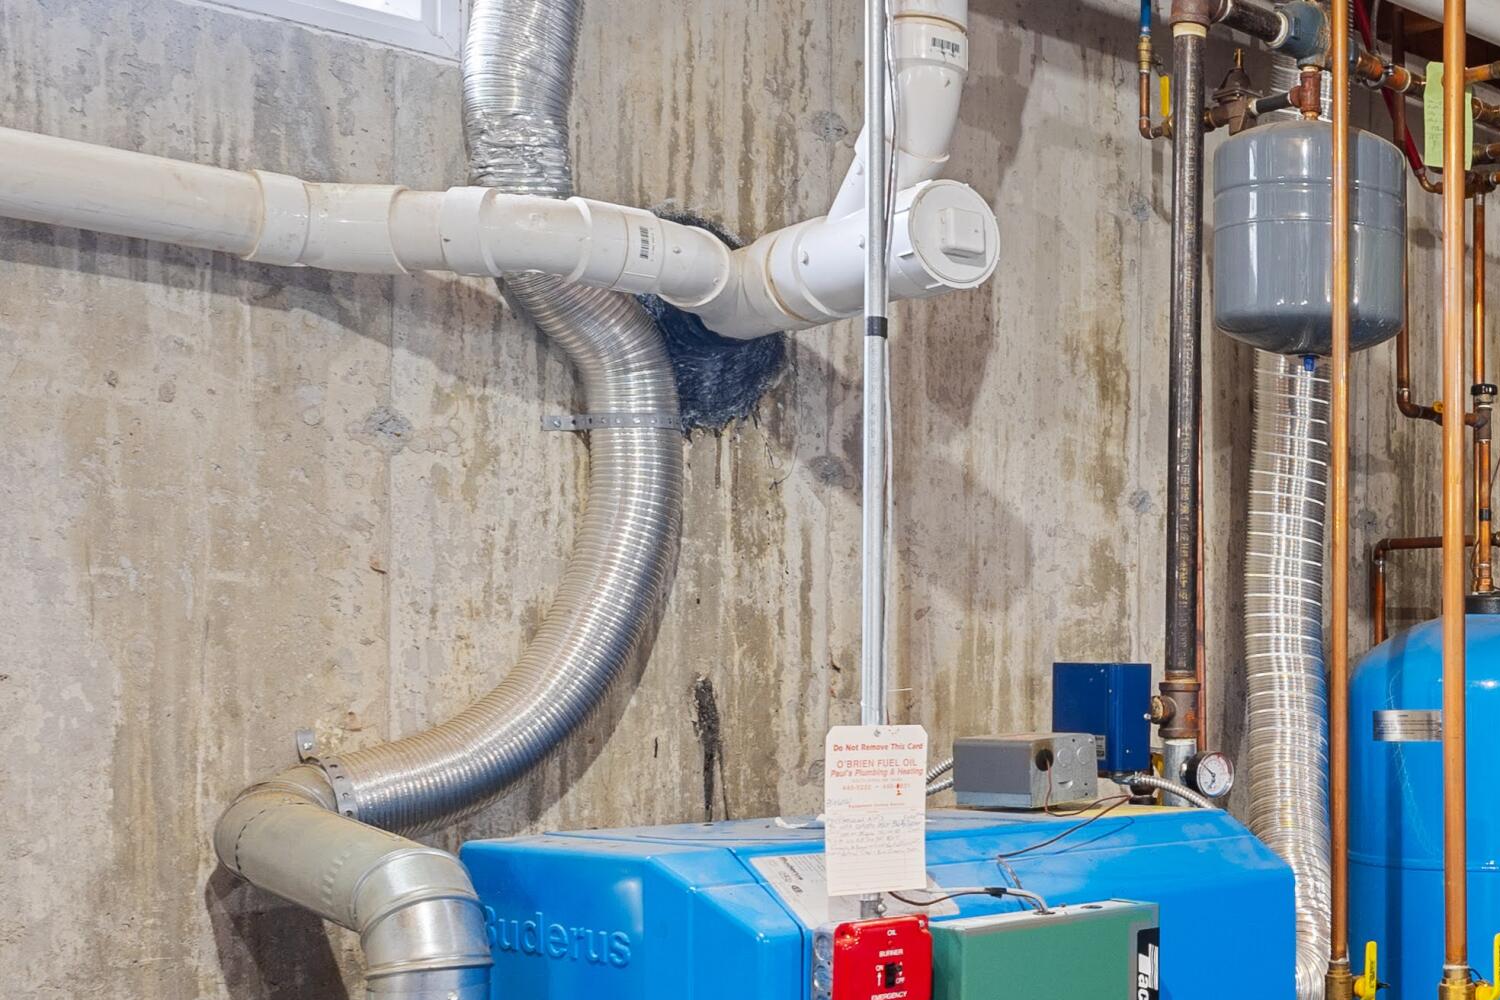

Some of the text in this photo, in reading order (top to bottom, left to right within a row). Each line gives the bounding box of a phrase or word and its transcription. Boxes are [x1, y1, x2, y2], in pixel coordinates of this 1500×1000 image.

[833, 744, 843, 752] Do
[861, 743, 889, 751] Remove
[907, 742, 923, 750] Card
[837, 758, 917, 768] O'BRIEN FUEL OIL
[855, 769, 888, 777] Plumbing
[897, 768, 924, 776] Heating
[886, 929, 897, 937] OIL
[879, 948, 904, 958] BURNER
[875, 964, 884, 972] ON
